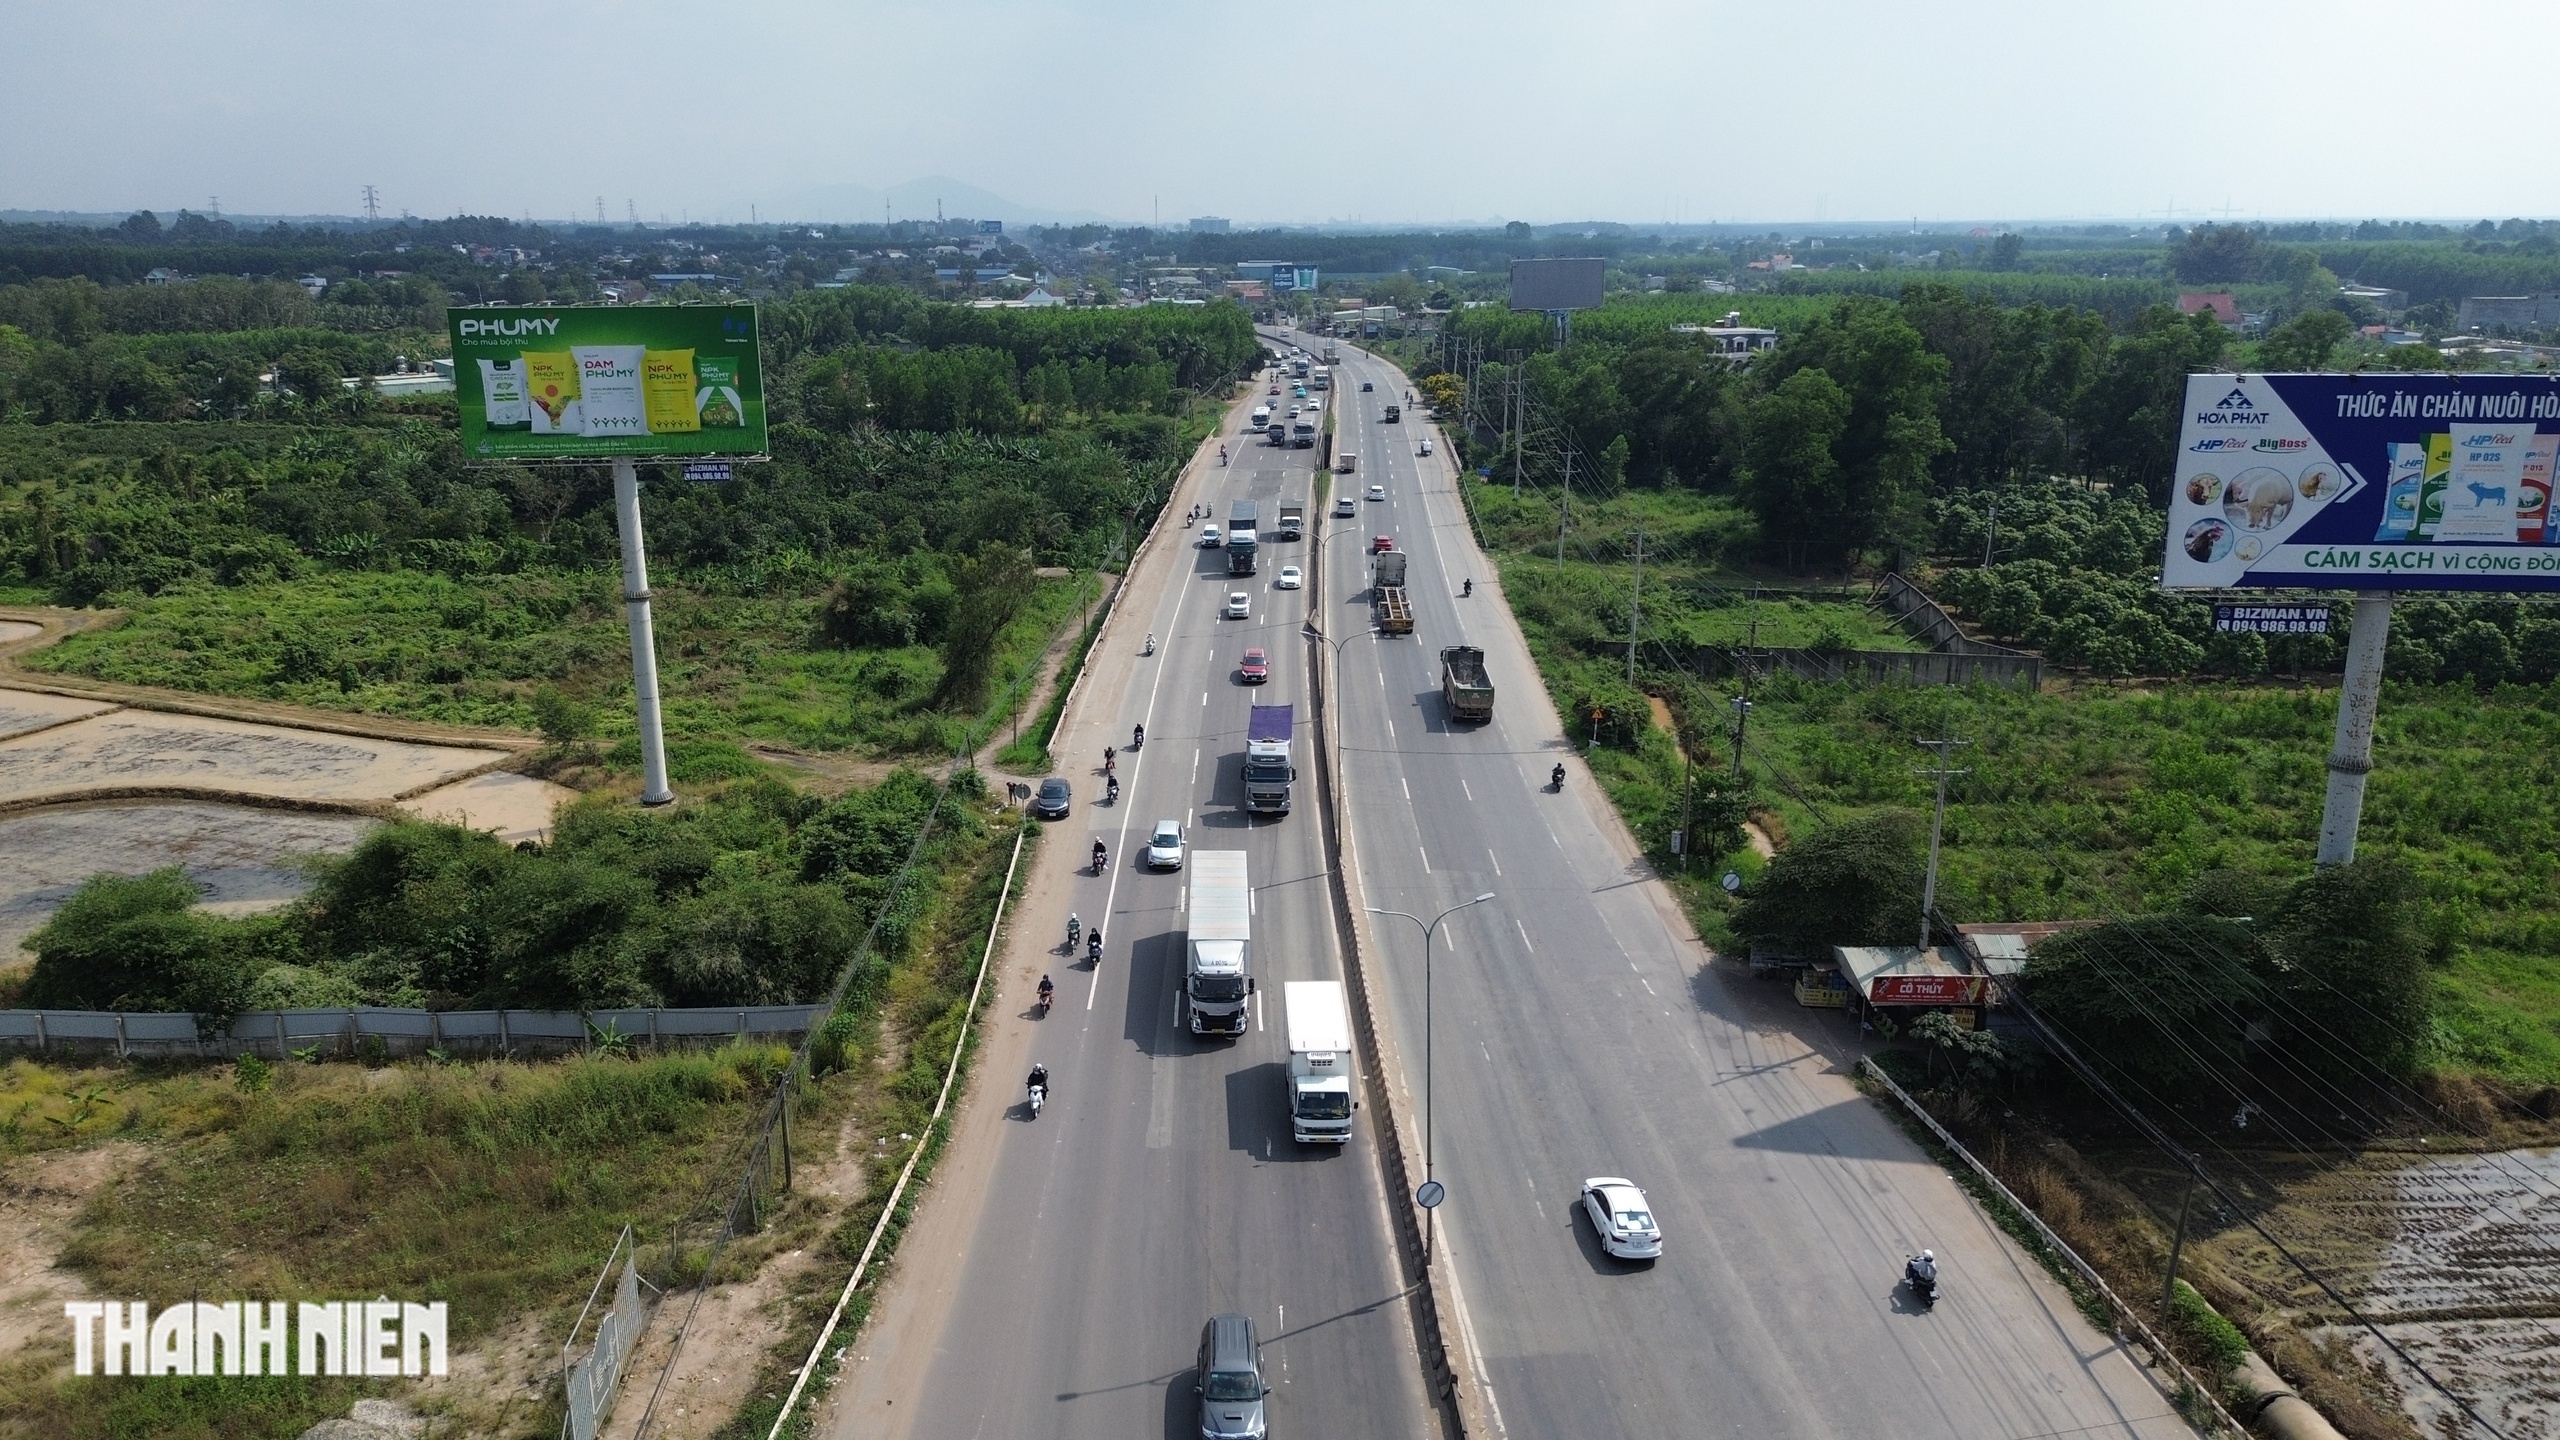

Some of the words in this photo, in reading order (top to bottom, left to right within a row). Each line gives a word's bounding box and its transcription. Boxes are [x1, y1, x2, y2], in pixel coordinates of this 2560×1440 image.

[461, 338, 479, 346] Cho
[480, 338, 498, 346] mùa
[500, 337, 513, 347] bội
[2336, 390, 2387, 418] THỨC
[2389, 390, 2418, 418] ĂN
[2421, 390, 2476, 418] CHĂN
[2479, 390, 2527, 419] NUÔI
[2259, 439, 2308, 450] BigBoss
[2470, 452, 2482, 462] HP
[2483, 452, 2501, 462] 02S
[2304, 547, 2361, 568] CÁM
[2368, 551, 2434, 574] SẠCH
[2442, 553, 2459, 570] VÌ
[2465, 553, 2521, 574] CỘNG
[2233, 607, 2328, 620] BIZMAN.VN
[2232, 620, 2326, 632] 094.986.98.98
[1900, 982, 1913, 994] CÔ
[1916, 982, 1944, 994] THÚY
